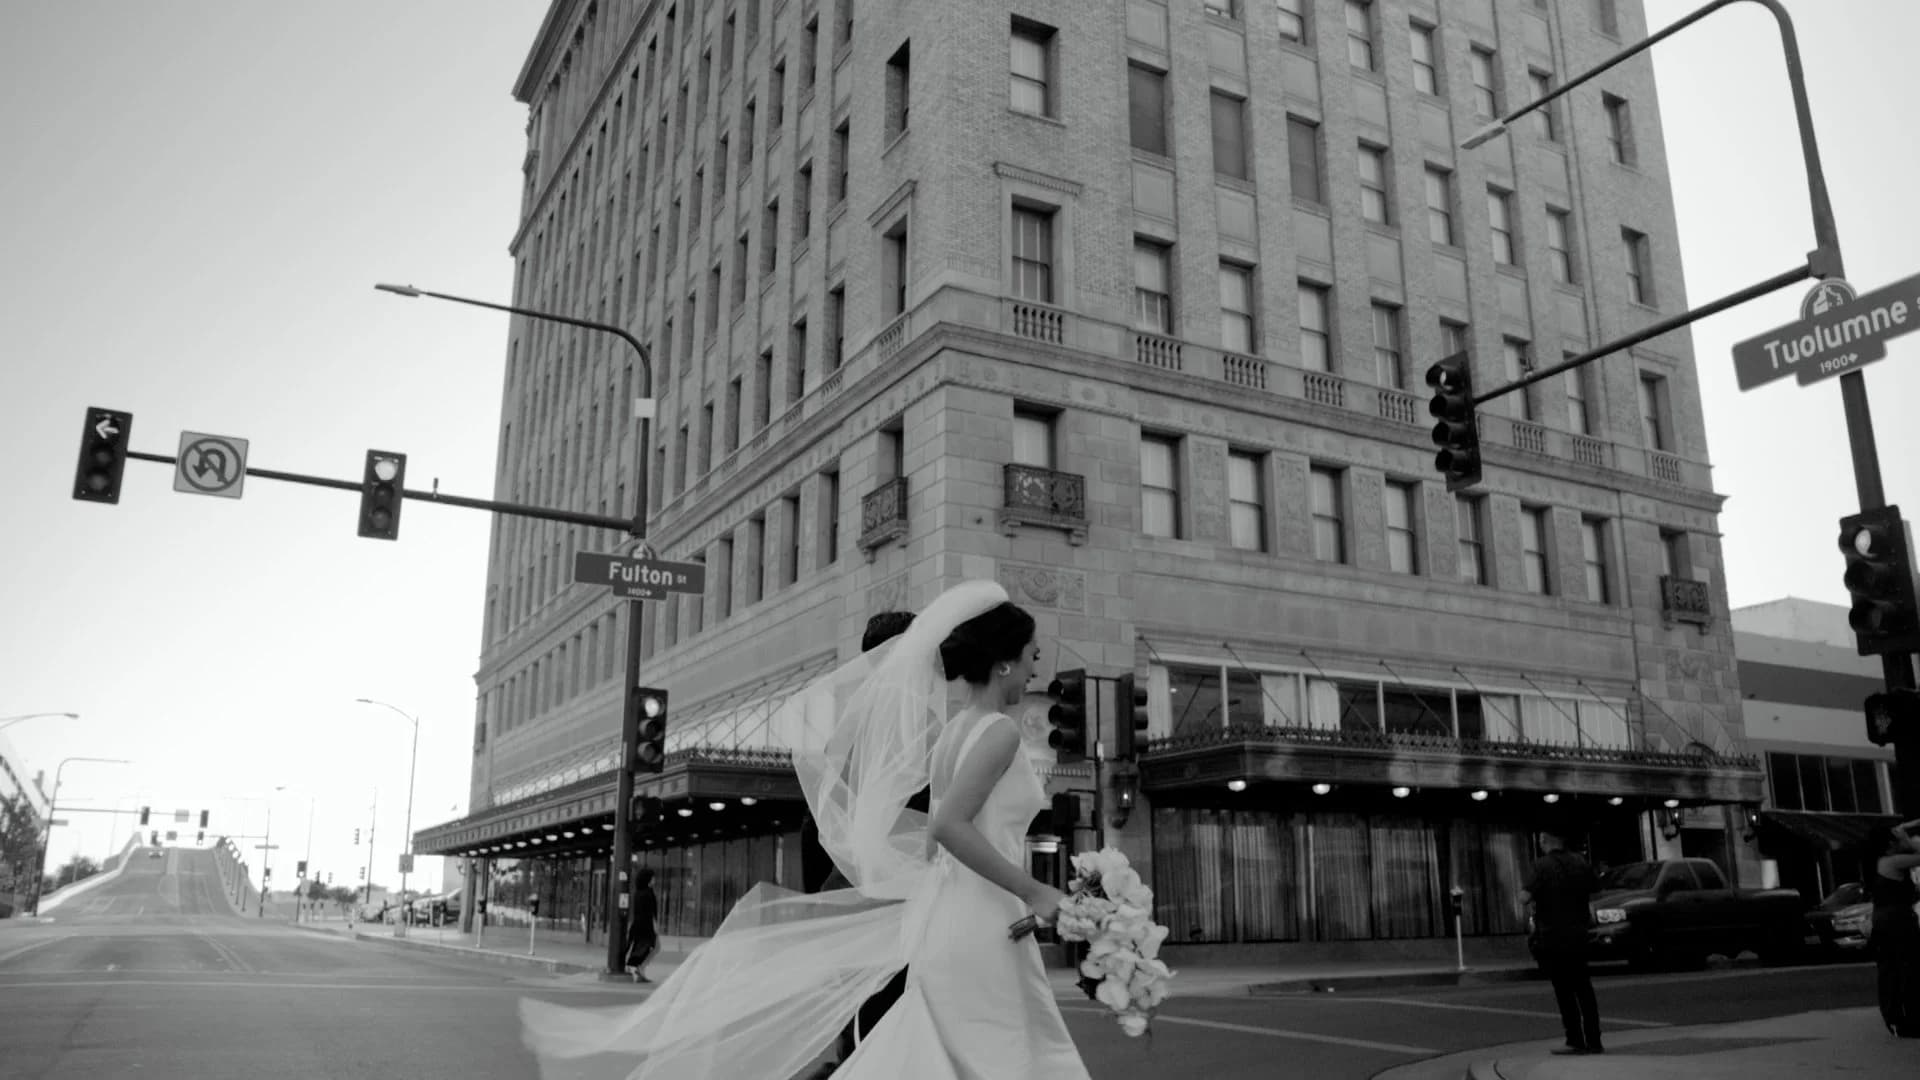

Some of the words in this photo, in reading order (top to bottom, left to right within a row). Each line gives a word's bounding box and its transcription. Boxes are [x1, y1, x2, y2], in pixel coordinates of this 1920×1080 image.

[1763, 300, 1908, 369] Tuolumne
[1820, 354, 1849, 374] 1900
[608, 561, 673, 586] Fulton
